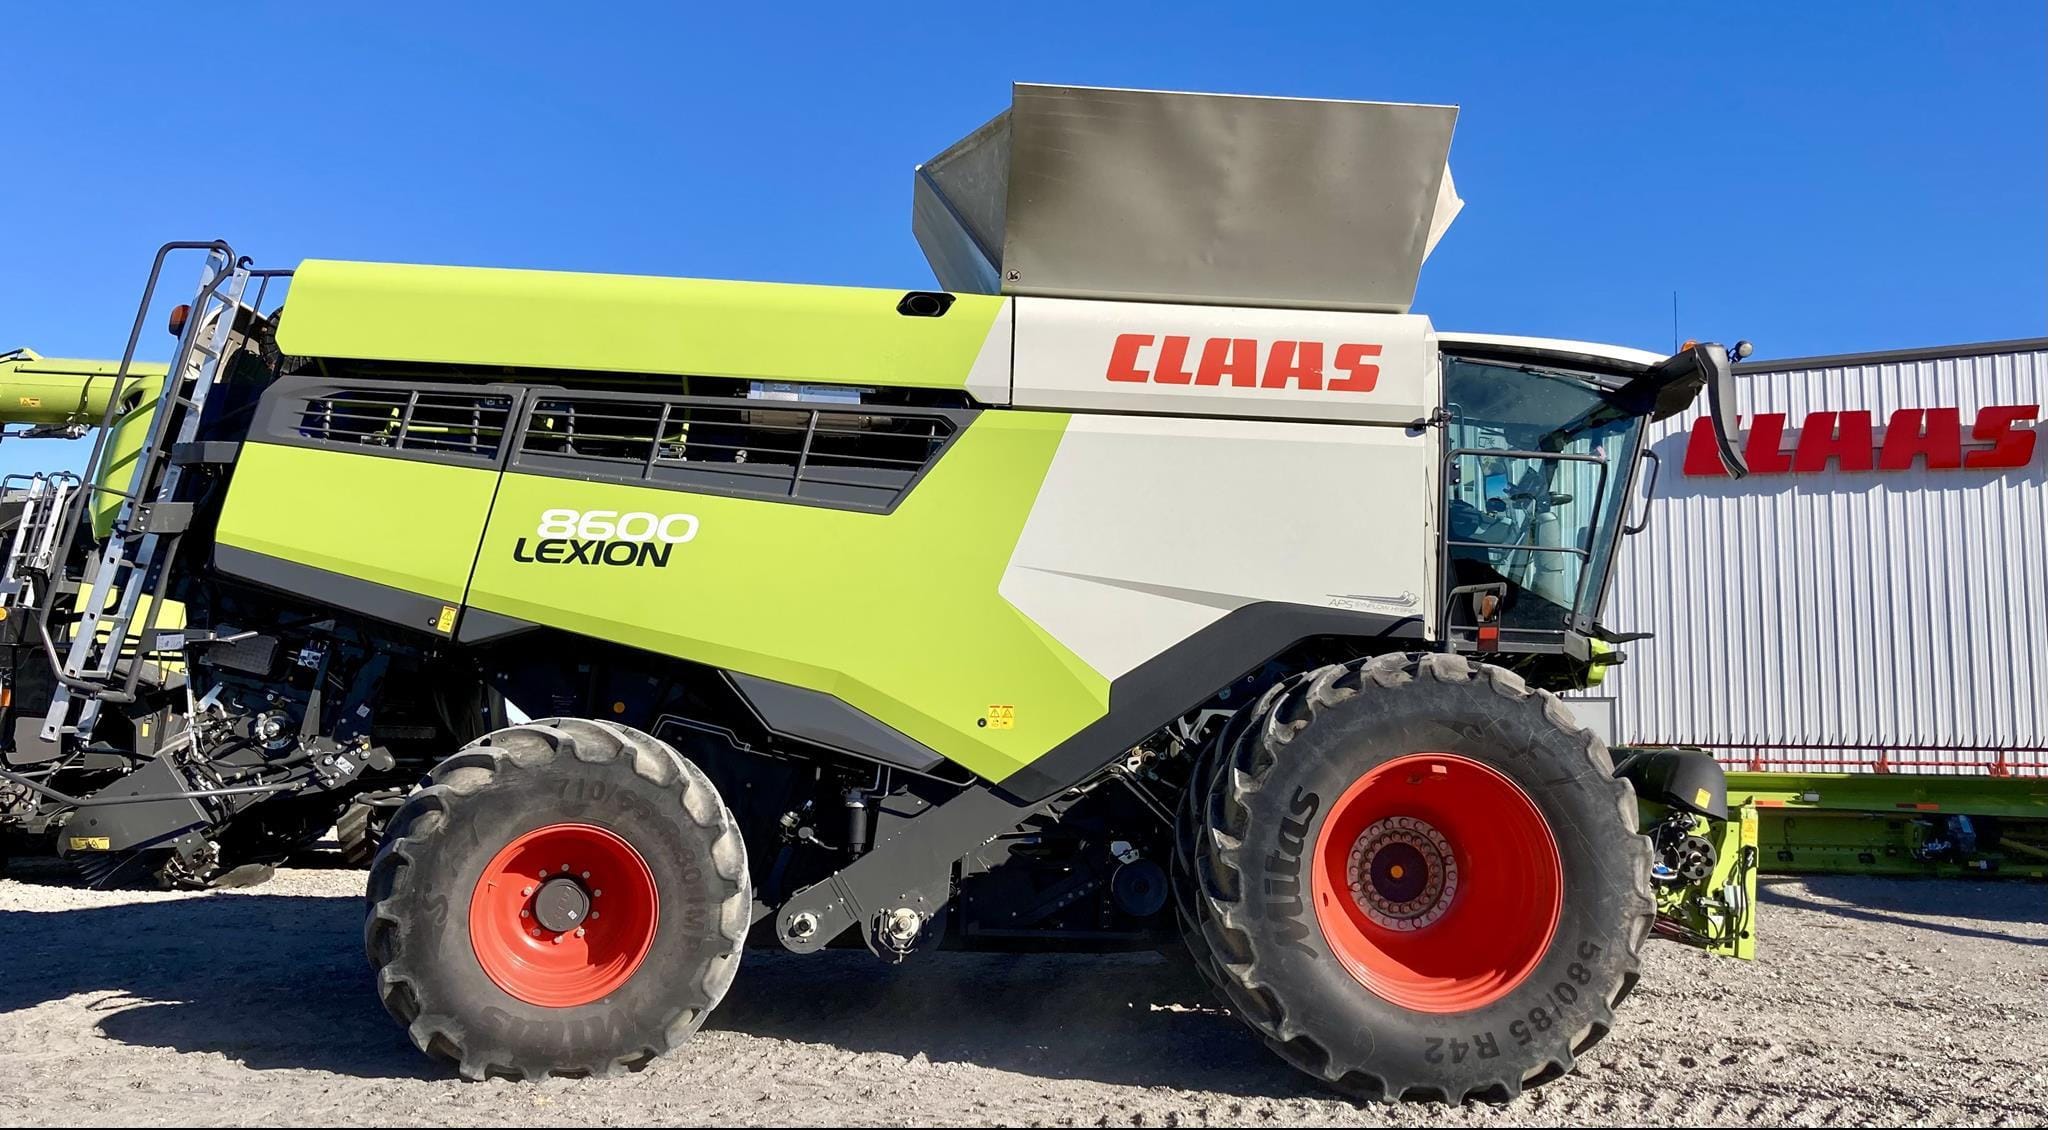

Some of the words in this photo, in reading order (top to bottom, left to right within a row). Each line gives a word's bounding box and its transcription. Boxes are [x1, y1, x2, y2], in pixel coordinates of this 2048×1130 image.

[1106, 333, 1383, 392] CLAAS
[537, 508, 699, 544] 8600
[513, 538, 673, 568] LEXION
[1264, 785, 1320, 960] Mitas
[1508, 940, 1602, 1046] 580/85
[1424, 1031, 1500, 1064] R42
